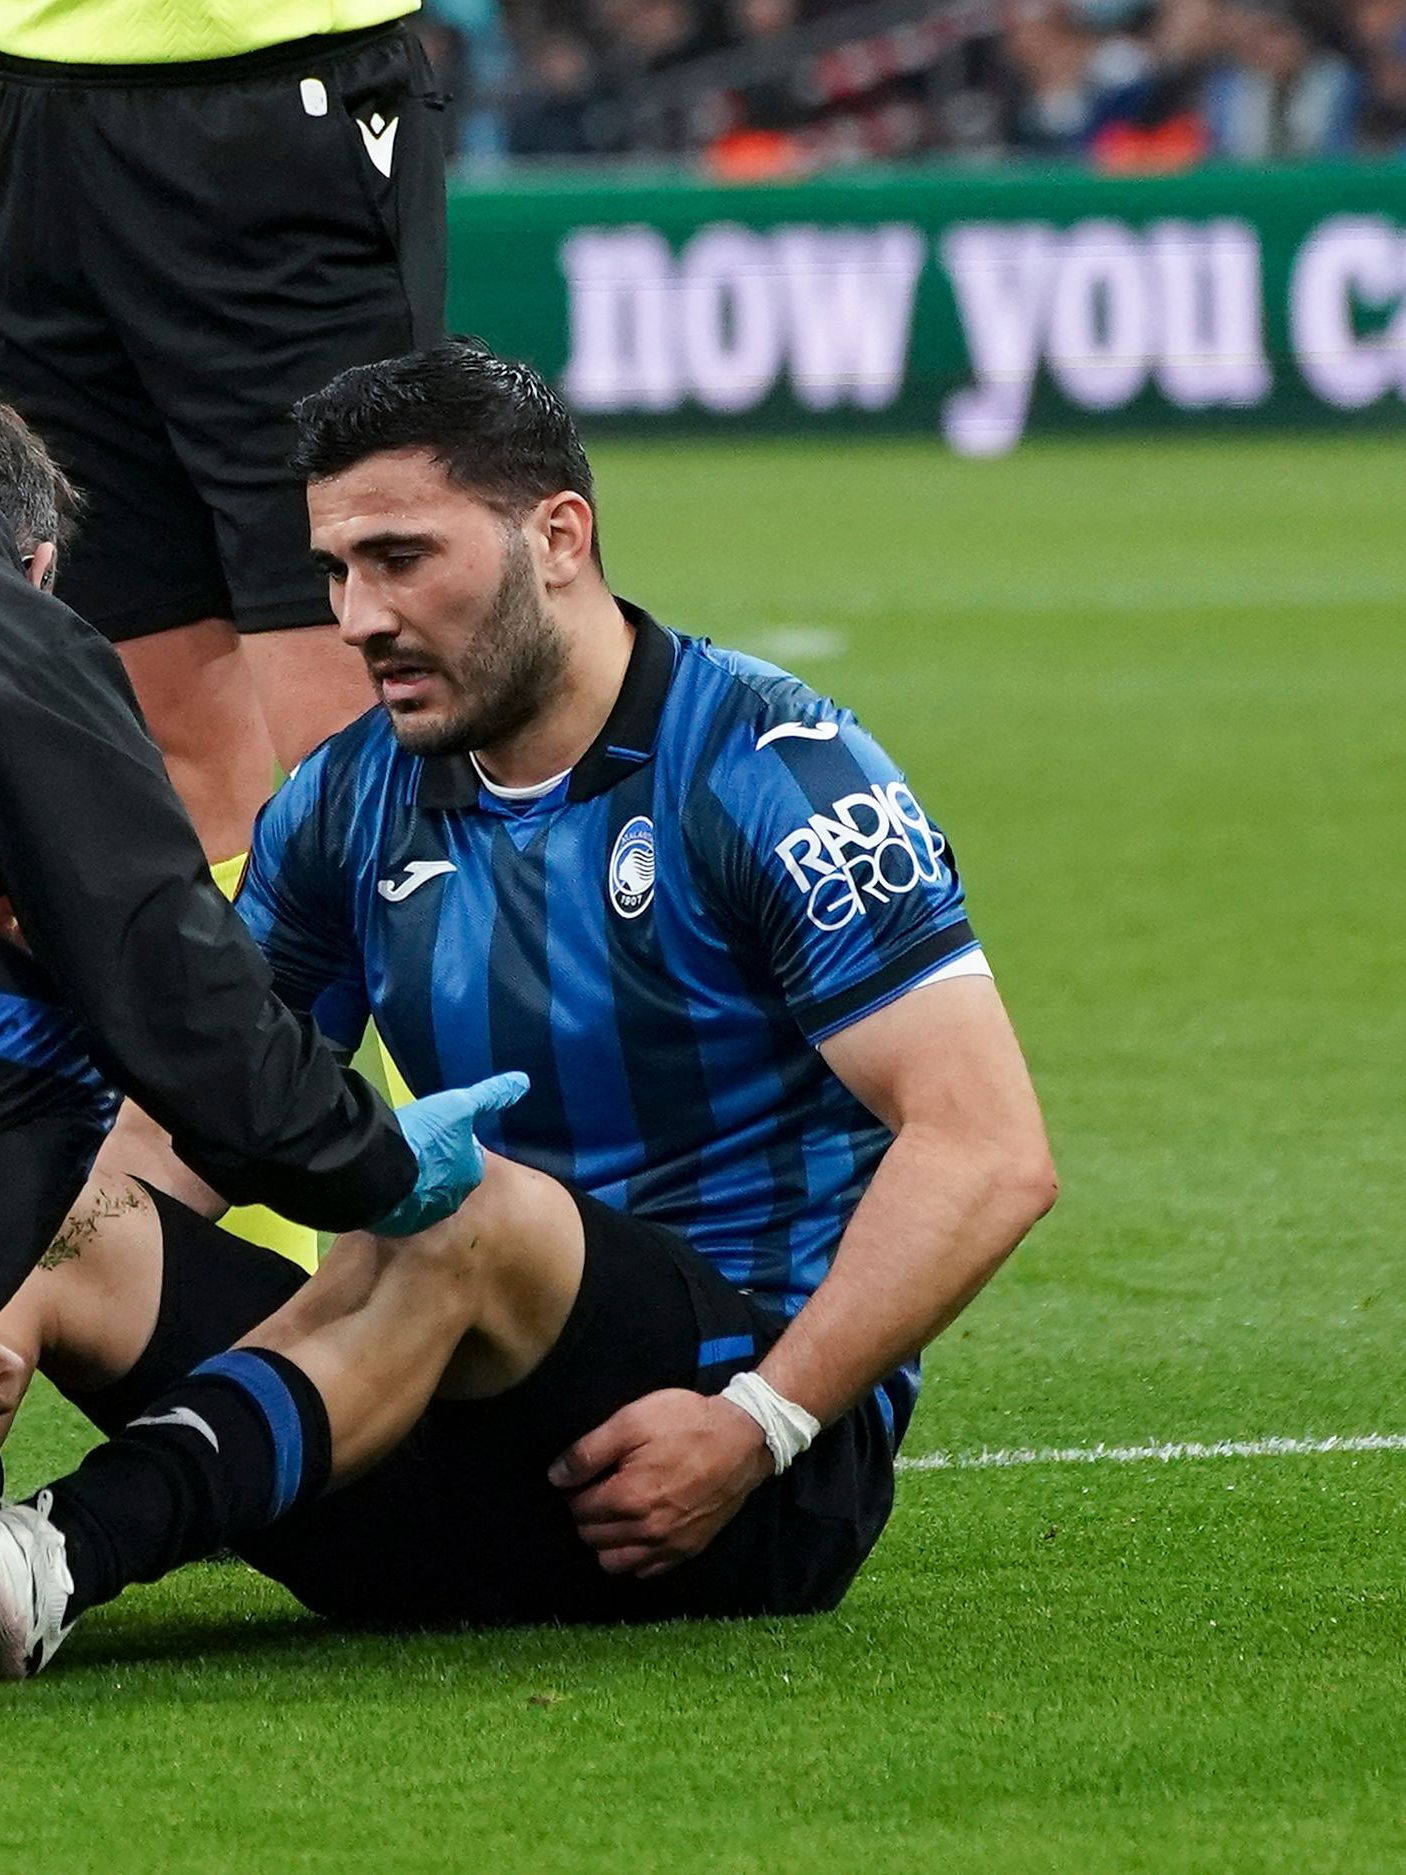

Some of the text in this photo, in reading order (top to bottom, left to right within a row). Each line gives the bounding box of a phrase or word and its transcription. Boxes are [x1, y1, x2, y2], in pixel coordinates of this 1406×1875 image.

[562, 223, 925, 413] now
[940, 217, 1274, 458] you
[775, 781, 927, 893] RADIO
[620, 894, 643, 906] 1907
